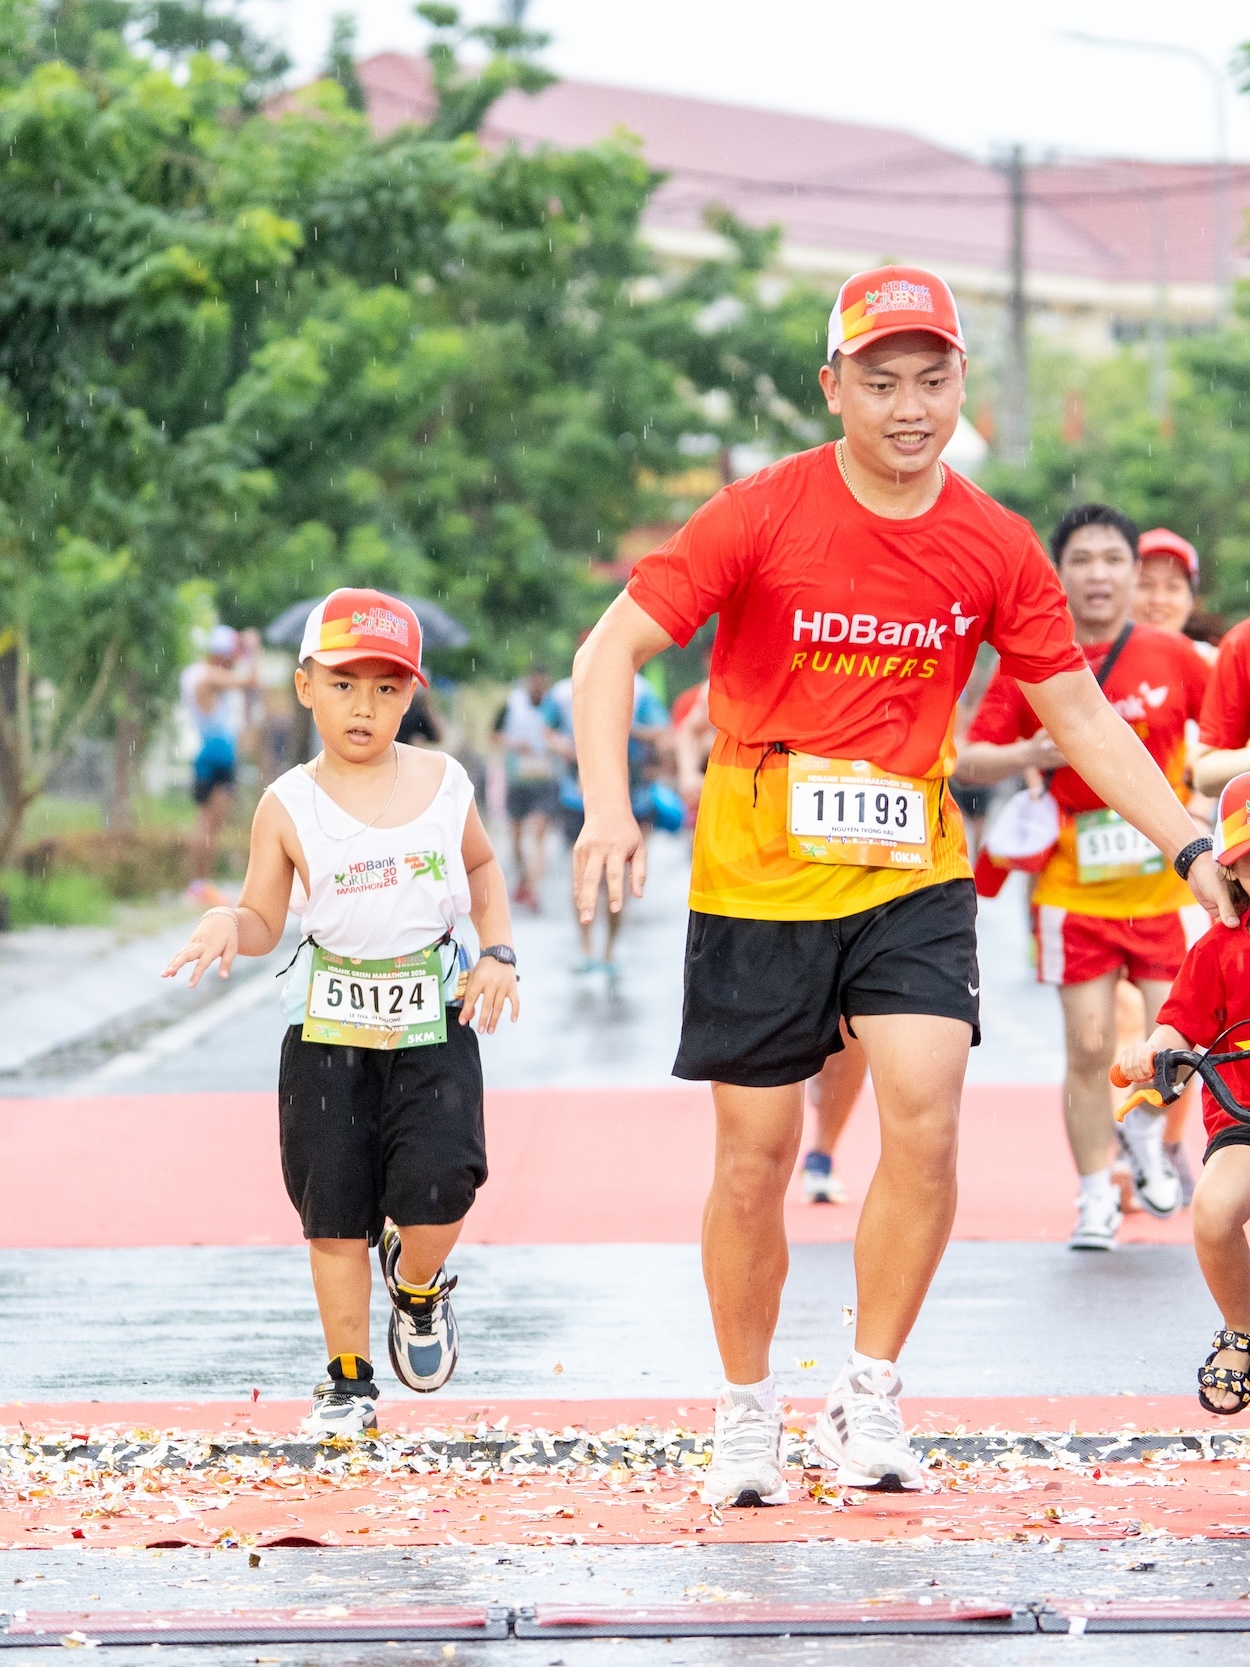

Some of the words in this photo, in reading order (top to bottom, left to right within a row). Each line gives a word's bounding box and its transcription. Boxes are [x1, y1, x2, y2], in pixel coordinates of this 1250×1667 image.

[793, 609, 948, 650] HDBank
[790, 650, 939, 679] RUNNERS
[813, 790, 908, 828] 11193
[890, 851, 922, 864] 10KM
[349, 857, 396, 874] HDBank
[383, 867, 397, 878] 20
[340, 871, 382, 887] GREEN
[384, 877, 398, 888] 26
[336, 882, 383, 895] MARATHON
[327, 965, 350, 976] HDBANK
[351, 970, 371, 979] GREEN
[372, 970, 409, 979] MARATHON
[411, 969, 427, 978] 2026
[327, 978, 424, 1014] 50124
[407, 1032, 435, 1044] 5KM
